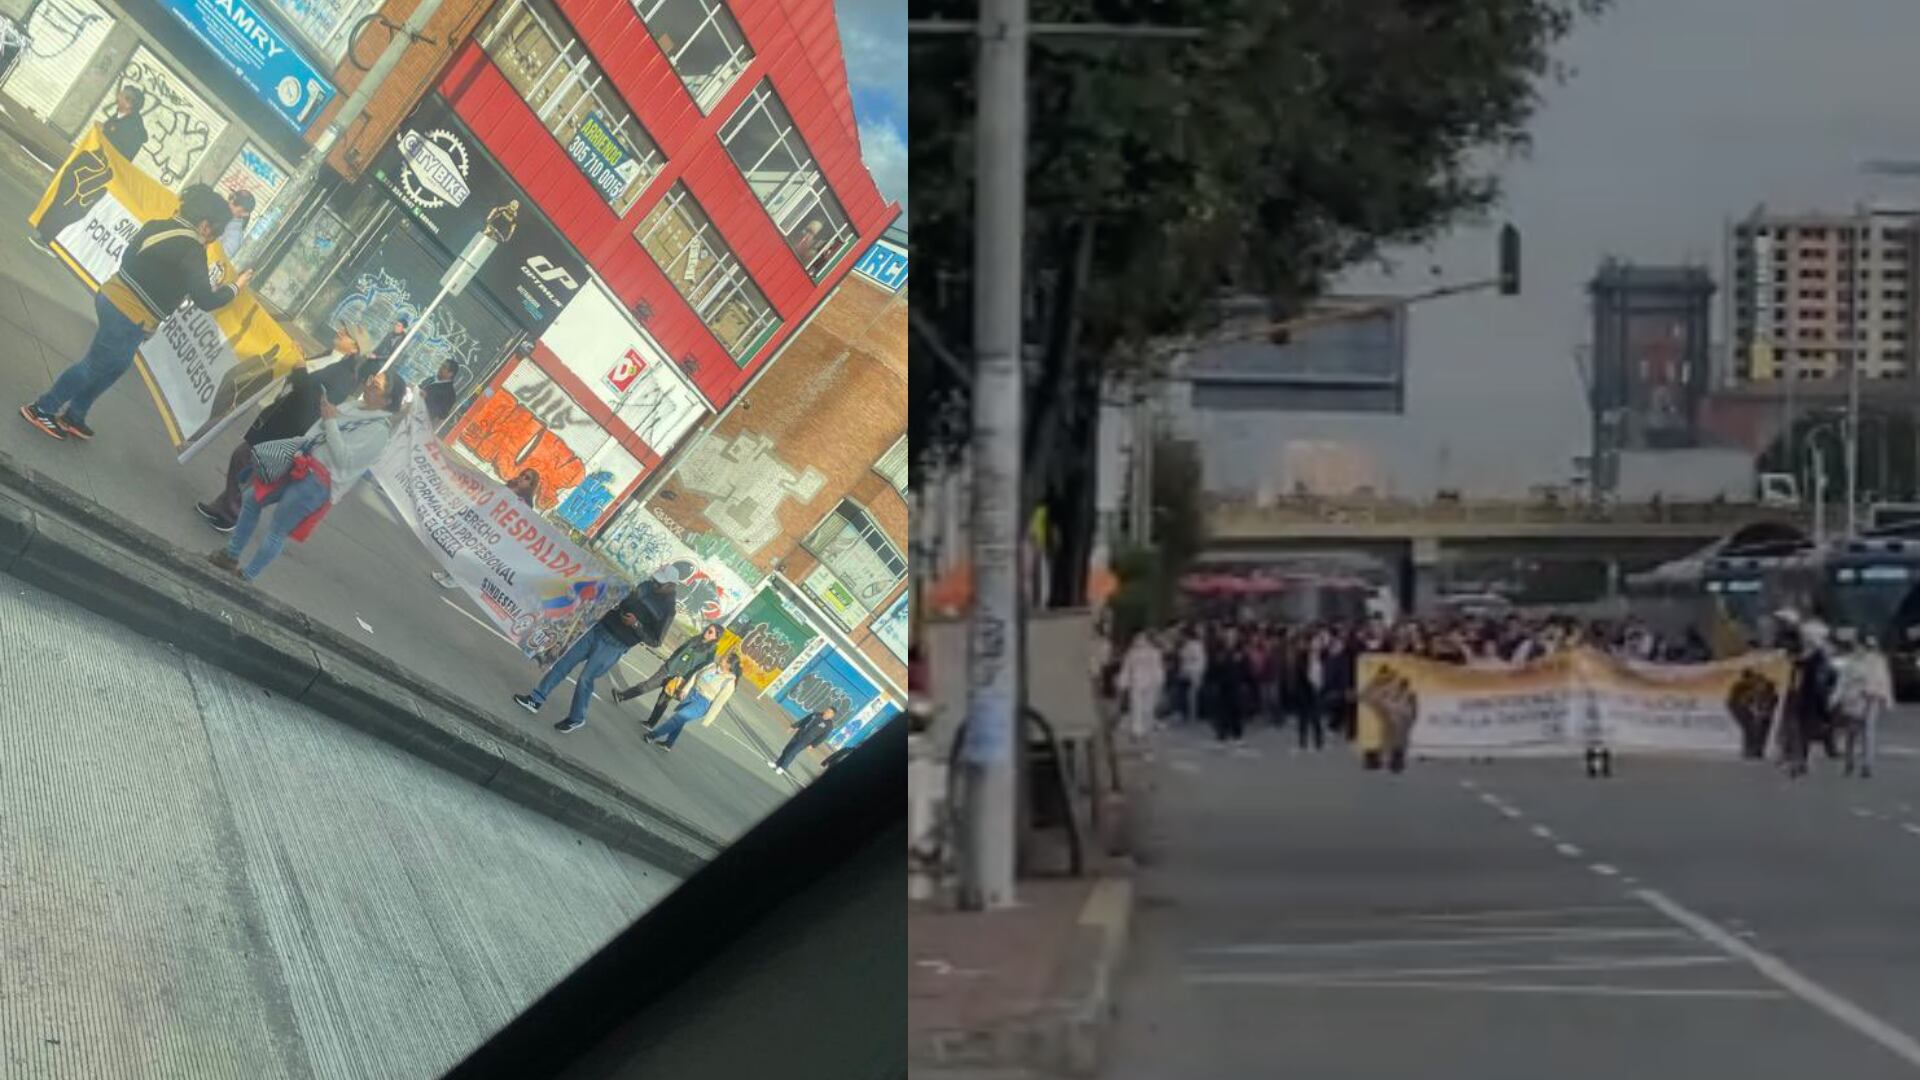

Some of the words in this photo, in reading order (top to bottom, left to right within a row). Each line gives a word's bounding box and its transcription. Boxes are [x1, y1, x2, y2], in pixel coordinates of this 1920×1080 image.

[566, 135, 590, 162] 305
[583, 151, 604, 177] 710
[597, 168, 622, 198] 0015
[85, 218, 111, 247] POR
[105, 237, 124, 261] LA
[189, 313, 224, 365] LUCHA
[431, 526, 463, 557] SENA
[456, 506, 502, 546] DERECHO
[488, 499, 582, 578] RESPALDA
[454, 526, 516, 585] PROFESIONAL
[482, 577, 521, 617] SINDESENA
